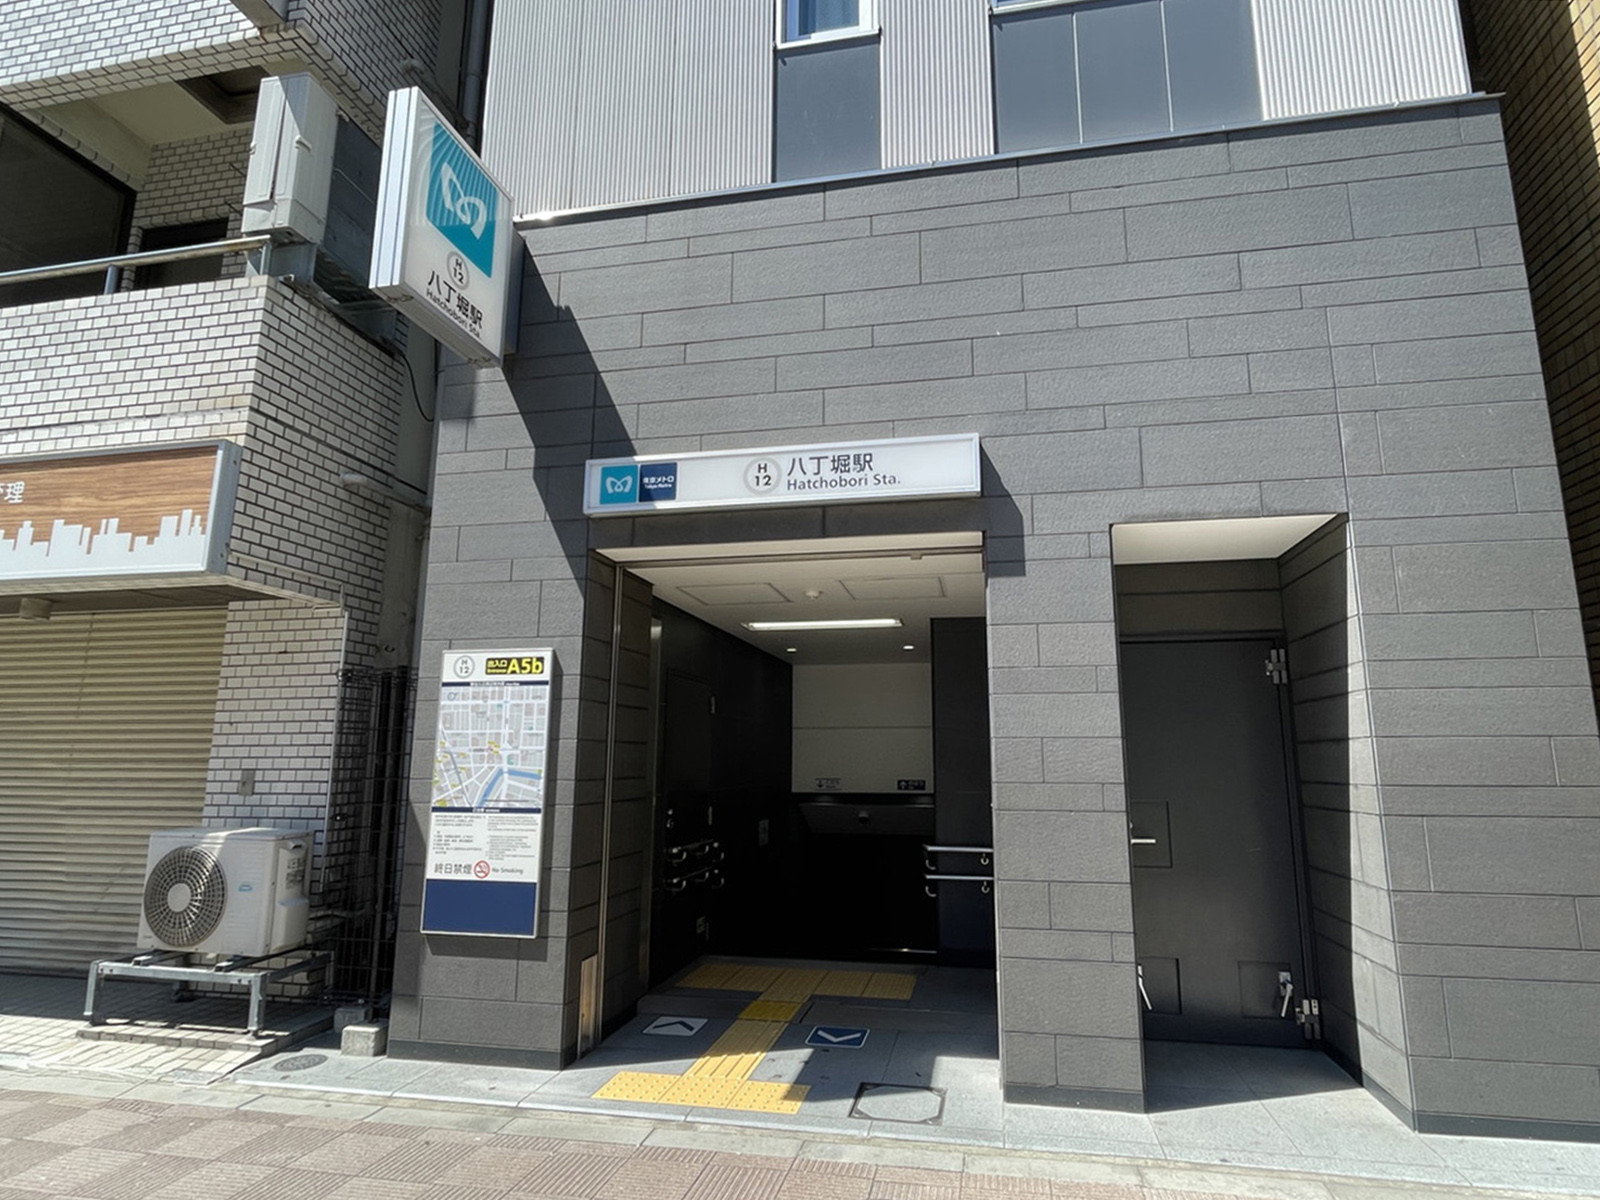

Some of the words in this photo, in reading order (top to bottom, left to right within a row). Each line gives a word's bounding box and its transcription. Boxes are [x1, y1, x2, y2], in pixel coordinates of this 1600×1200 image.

[455, 258, 463, 271] H
[453, 267, 464, 285] 12
[426, 288, 468, 329] Hatchobori
[428, 270, 483, 329] 八丁堀駅
[757, 463, 768, 474] H
[787, 453, 874, 476] 八丁堀駅
[755, 474, 772, 487] 12
[787, 474, 869, 491] Hatchobori
[873, 473, 901, 487] Sta.
[507, 657, 543, 675] A5b
[434, 863, 472, 875] 終日禁煙
[501, 866, 524, 875] Smoking
